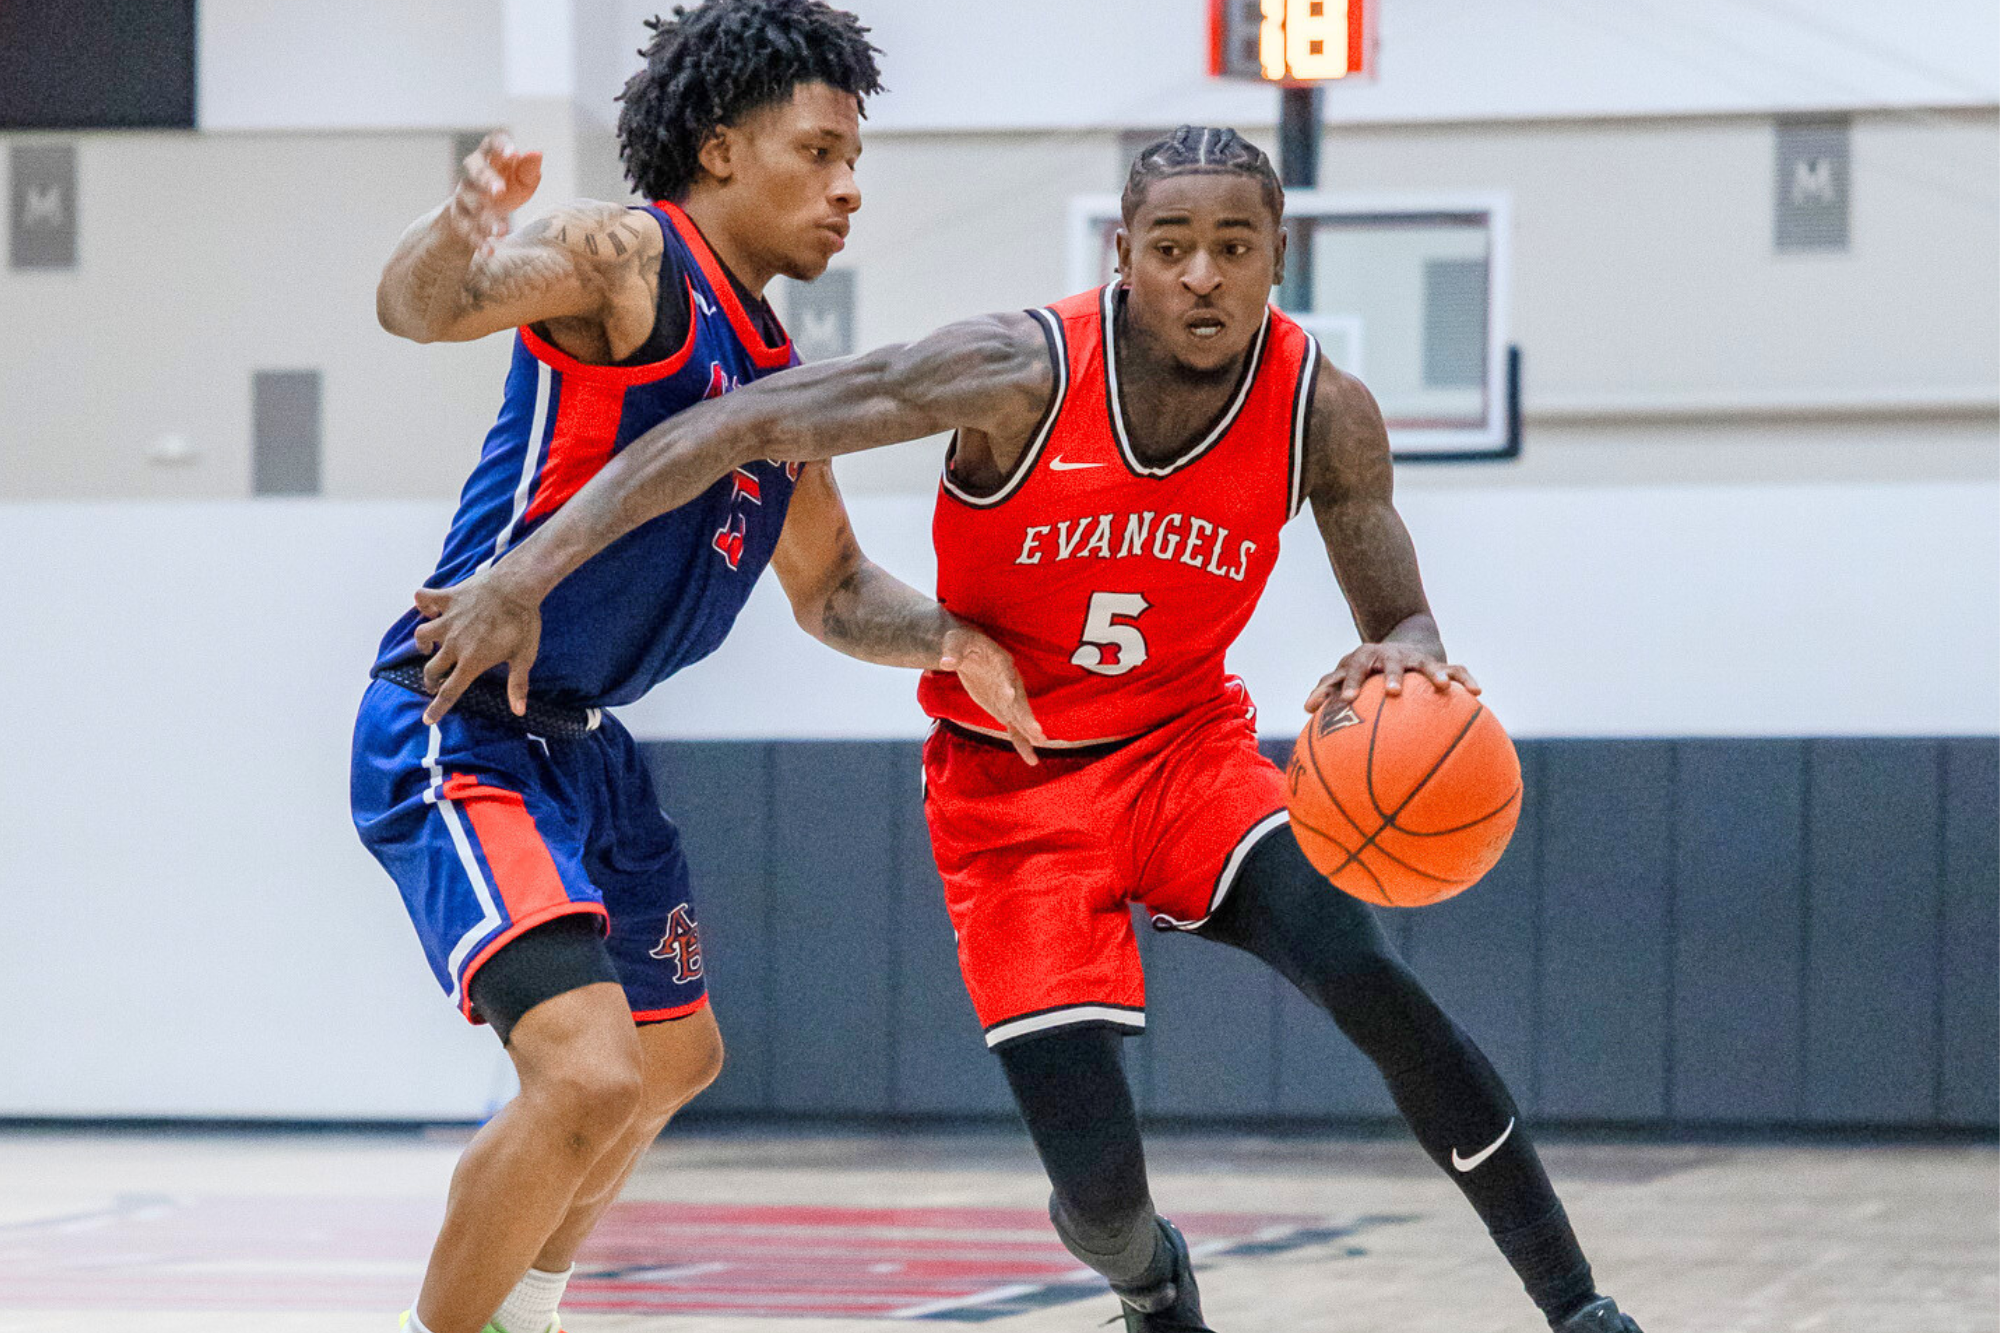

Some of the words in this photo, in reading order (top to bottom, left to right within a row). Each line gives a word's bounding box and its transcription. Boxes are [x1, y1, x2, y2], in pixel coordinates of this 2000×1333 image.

[1792, 160, 1835, 202] M
[1014, 511, 1257, 582] EVANGELS
[1069, 590, 1154, 676] 5
